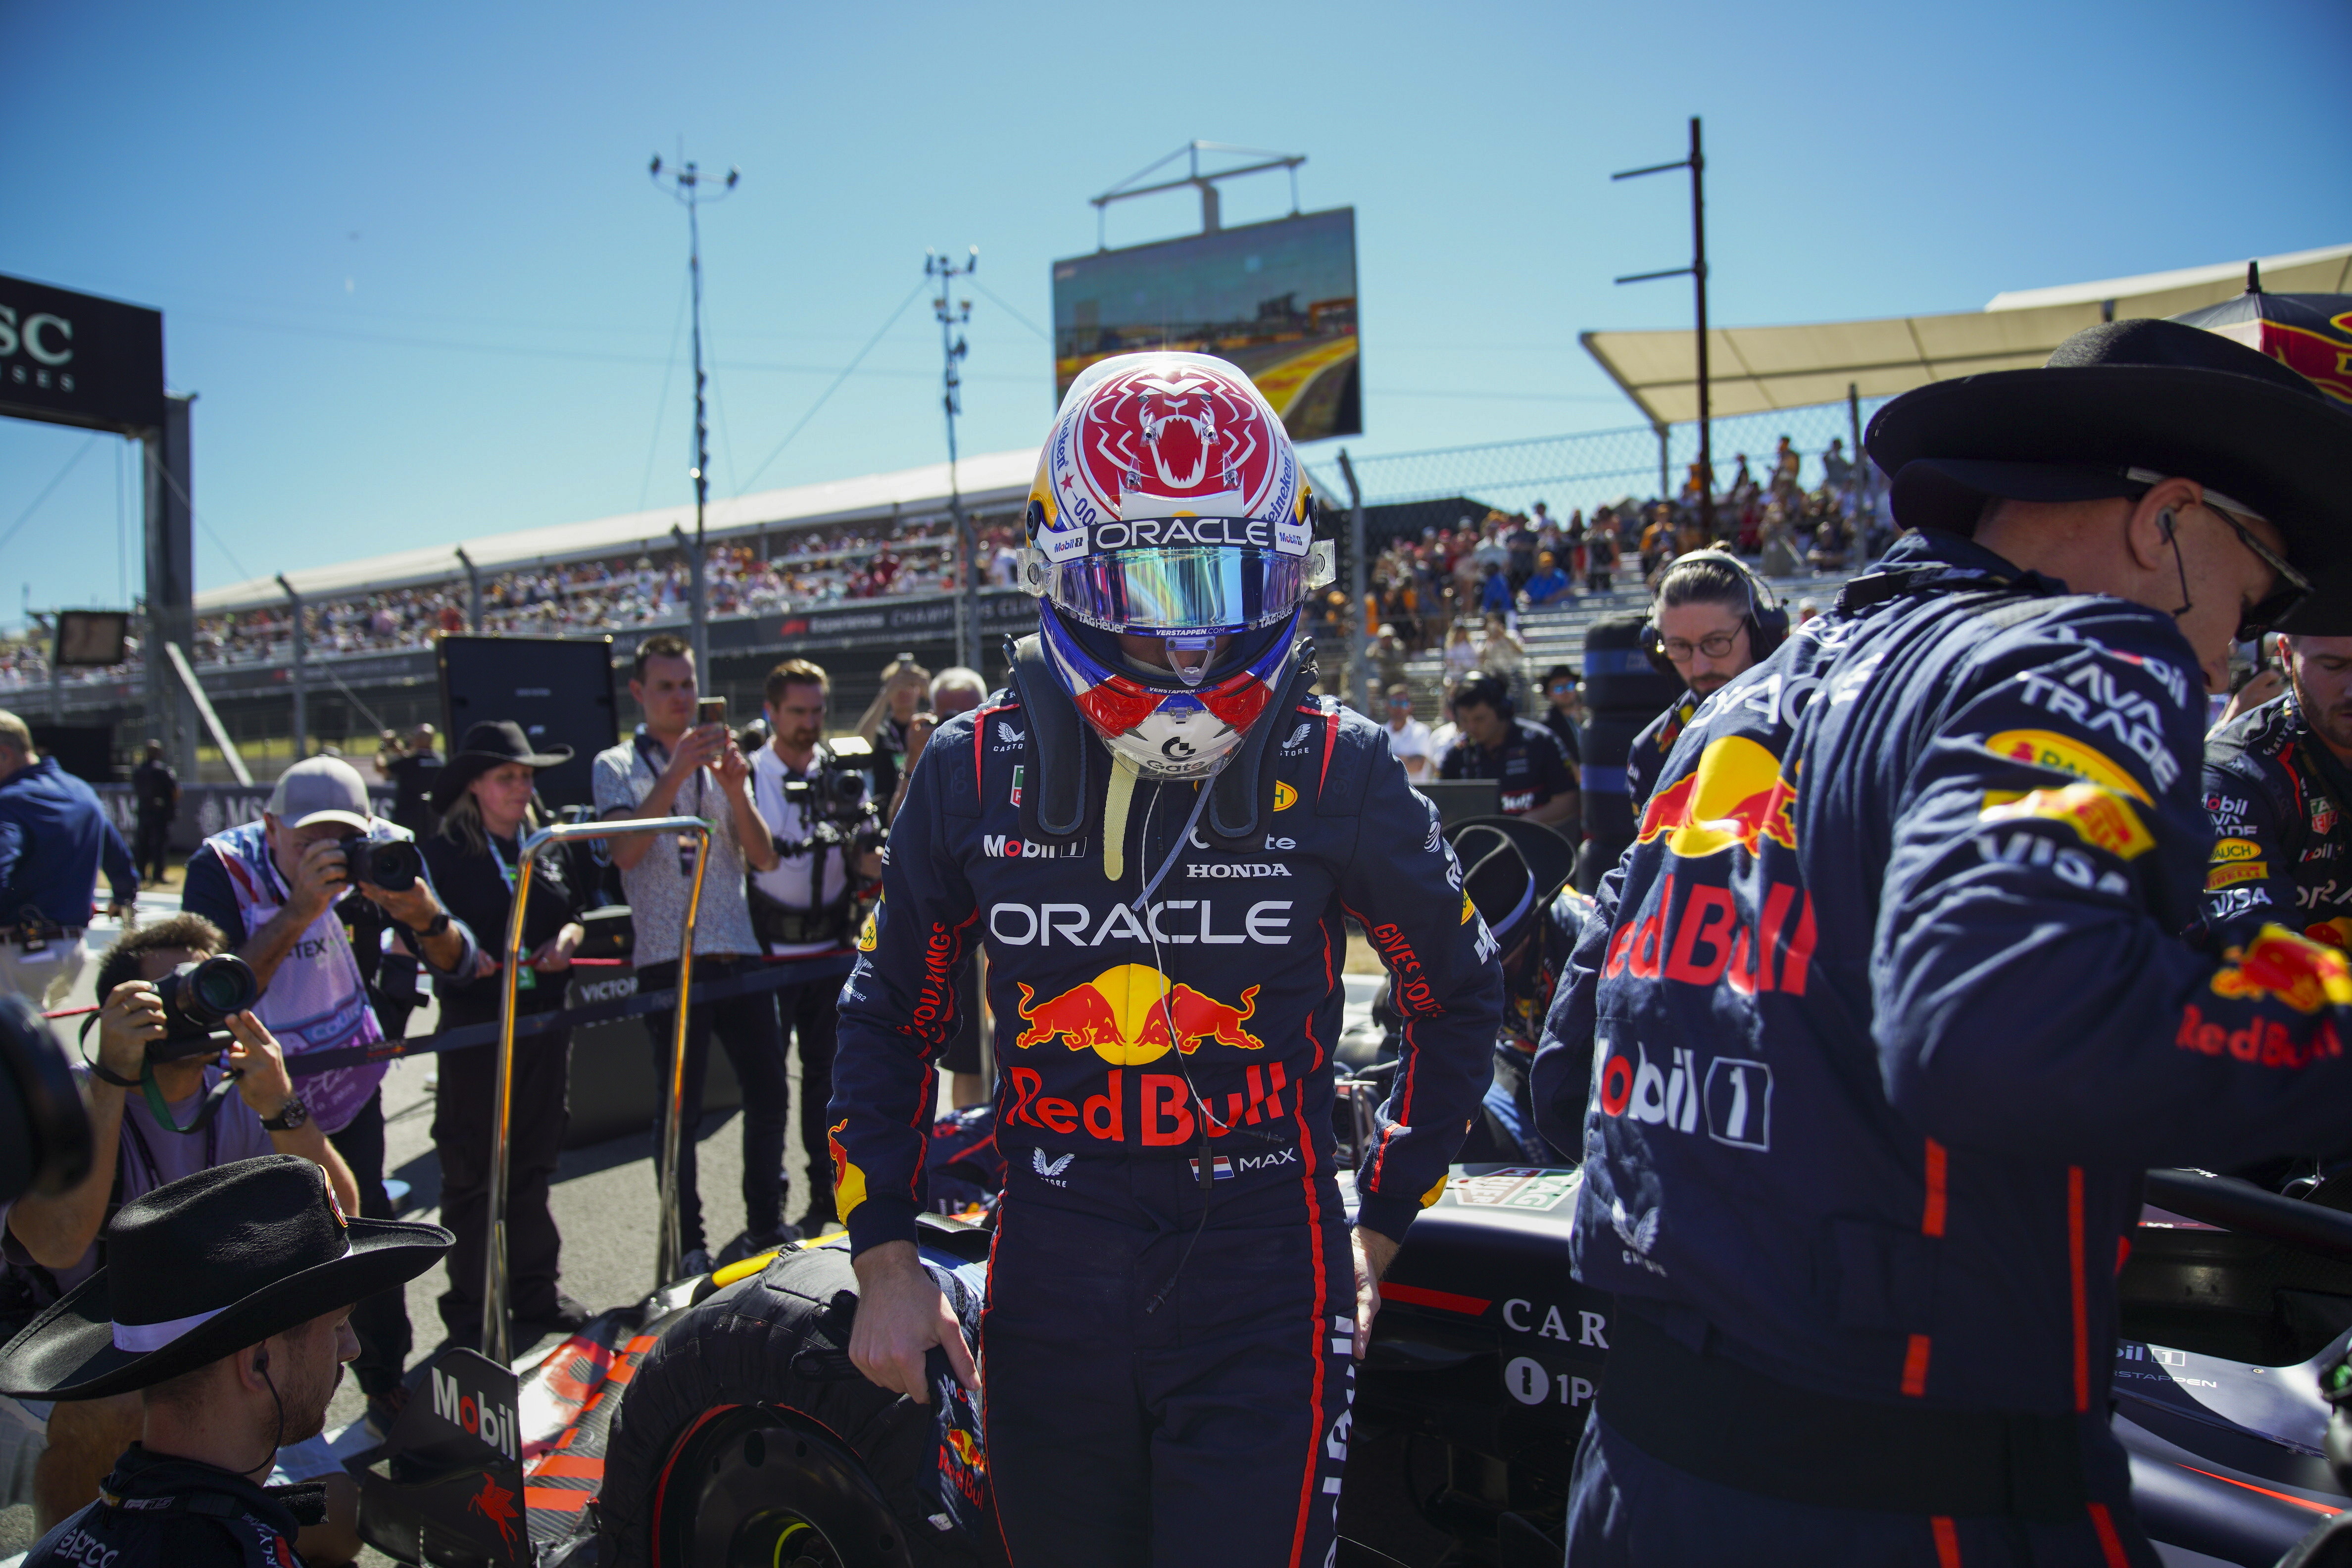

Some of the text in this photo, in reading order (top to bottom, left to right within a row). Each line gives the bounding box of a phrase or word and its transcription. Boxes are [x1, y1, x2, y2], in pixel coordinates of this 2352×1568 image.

[1055, 539, 1074, 553] Mobil
[1096, 519, 1270, 549] ORACLE
[1279, 532, 1297, 544] Mobil
[1156, 627, 1225, 636] VERSTAPPEN.COM
[1149, 686, 1212, 694] VERSTAPPEN.COM
[2064, 662, 2166, 736] AVA
[2020, 673, 2181, 792] TRADE
[993, 743, 1024, 752] CASTO
[1146, 760, 1205, 772] Gate
[983, 834, 1055, 858] Mobil
[1189, 826, 1296, 850] Gte
[2211, 845, 2252, 859] AUCH
[1186, 863, 1292, 878] HONDA
[2209, 886, 2273, 918] VISA
[990, 900, 1293, 946] ORACLE
[1599, 874, 1675, 980] ed
[1664, 881, 1818, 997] Bull
[289, 938, 327, 959] TEX
[1006, 1061, 1286, 1146] Red Bull
[1239, 1147, 1297, 1172] MAX
[1040, 1177, 1067, 1188] TORE
[1503, 1298, 1610, 1349] CAR
[1557, 1373, 1595, 1407] 1P
[432, 1366, 516, 1462] Mobil
